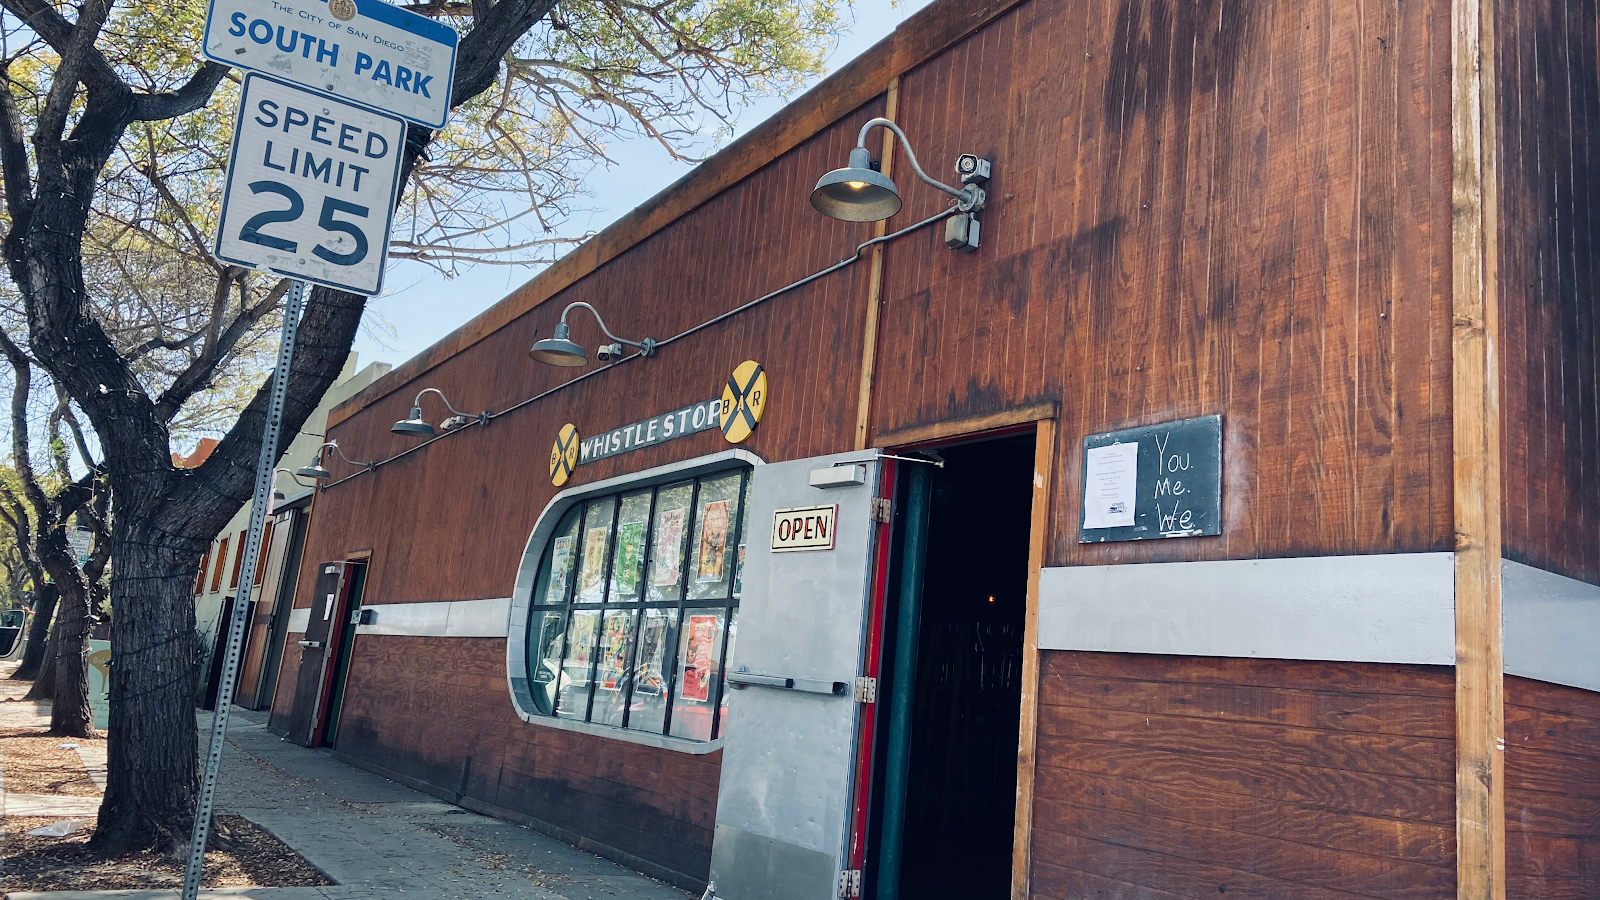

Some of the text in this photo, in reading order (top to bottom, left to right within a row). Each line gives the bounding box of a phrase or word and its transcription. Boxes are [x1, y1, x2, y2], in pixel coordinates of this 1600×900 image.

[272, 1, 405, 52] THE CITY OF SAN DIEGO
[228, 11, 340, 67] SOUTH
[354, 52, 435, 99] PARK
[254, 99, 389, 159] SPEED
[263, 140, 370, 192] LIMIT
[238, 180, 370, 266] 25
[722, 390, 761, 415] BAR
[580, 399, 722, 462] WHISTLE STOP
[1154, 431, 1194, 475] You.
[779, 515, 828, 541] OPEN
